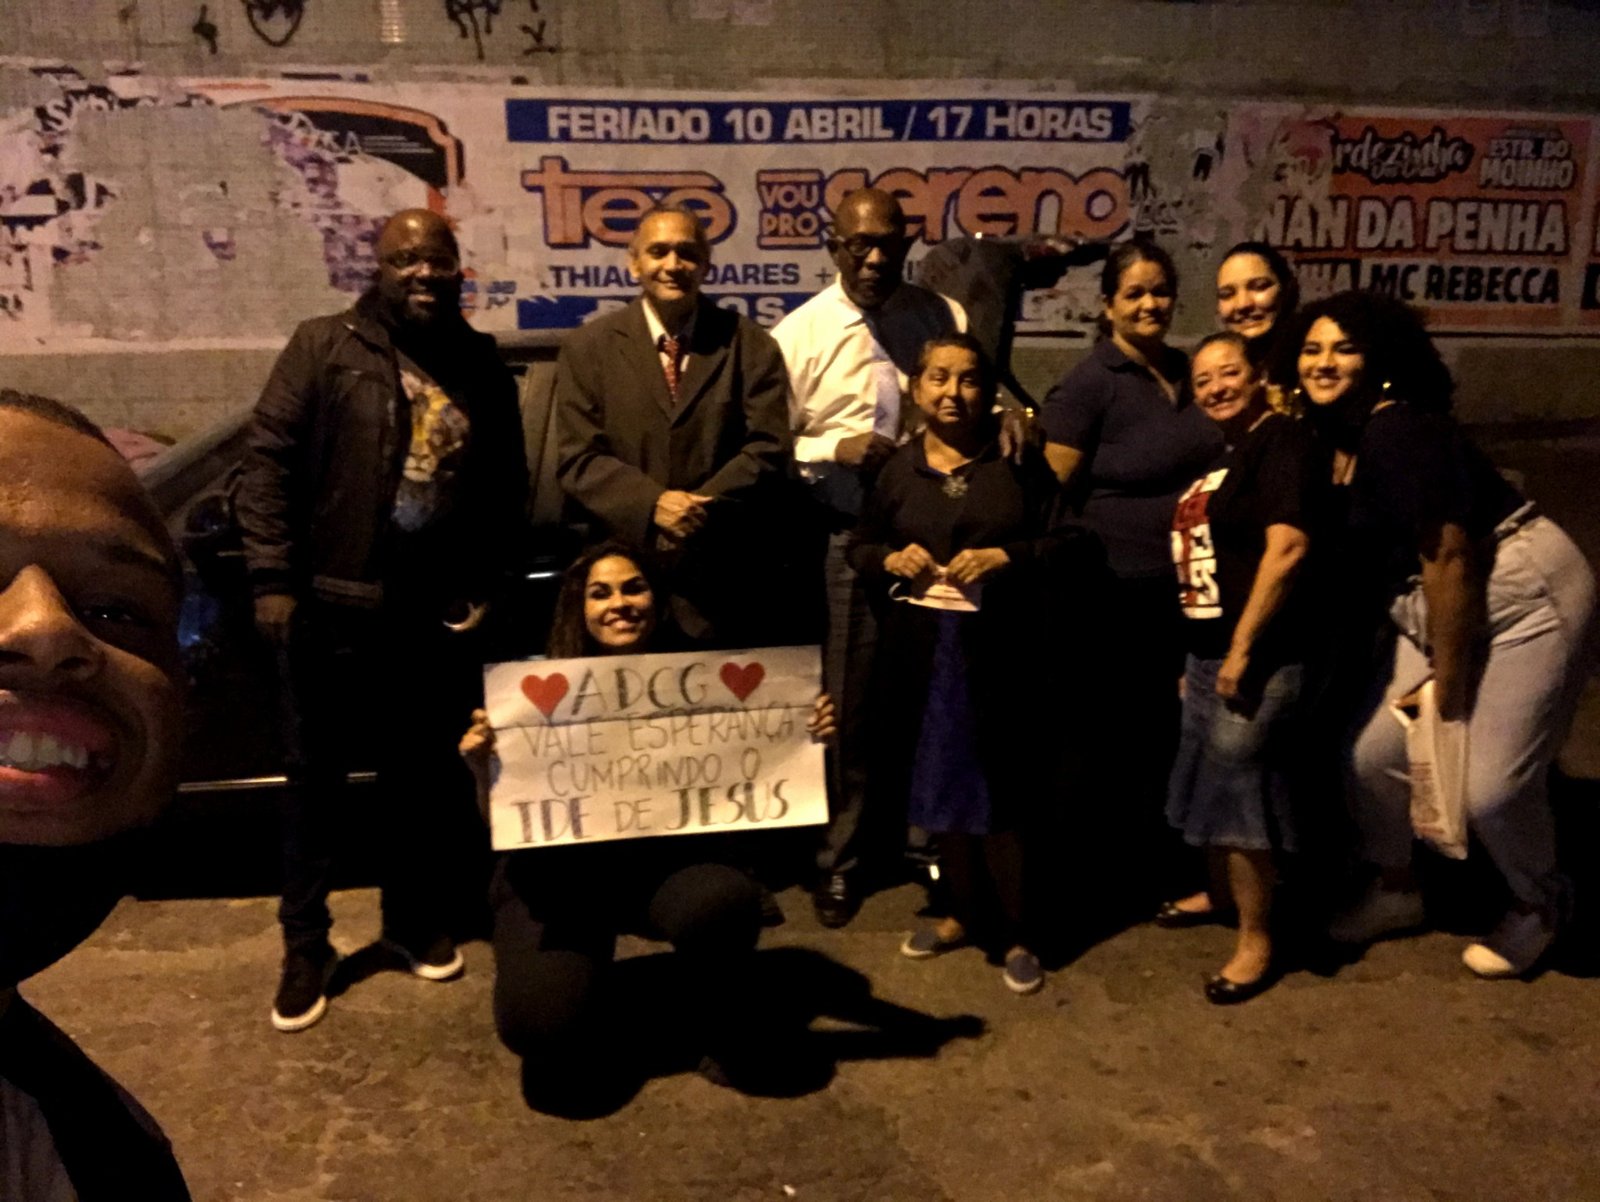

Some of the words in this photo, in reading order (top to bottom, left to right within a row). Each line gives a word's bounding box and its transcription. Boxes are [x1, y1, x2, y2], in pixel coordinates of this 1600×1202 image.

[547, 105, 710, 140] FERIADO
[724, 108, 772, 141] 10
[783, 107, 894, 140] ABRIL
[927, 106, 972, 138] 17
[986, 106, 1113, 139] HORAS
[1480, 158, 1574, 188] MOINHO
[761, 184, 820, 210] VOU
[761, 212, 820, 236] PRO
[1356, 201, 1414, 248] DA
[1426, 202, 1567, 251] PENHA
[1368, 263, 1420, 301] MC
[1424, 265, 1560, 304] REBECCA
[571, 662, 708, 716] ADCG
[516, 716, 606, 758] VALE
[547, 753, 722, 797] CUMPRINDO
[740, 747, 762, 781] O
[613, 798, 653, 832] DE
[665, 778, 789, 831] JESUS
